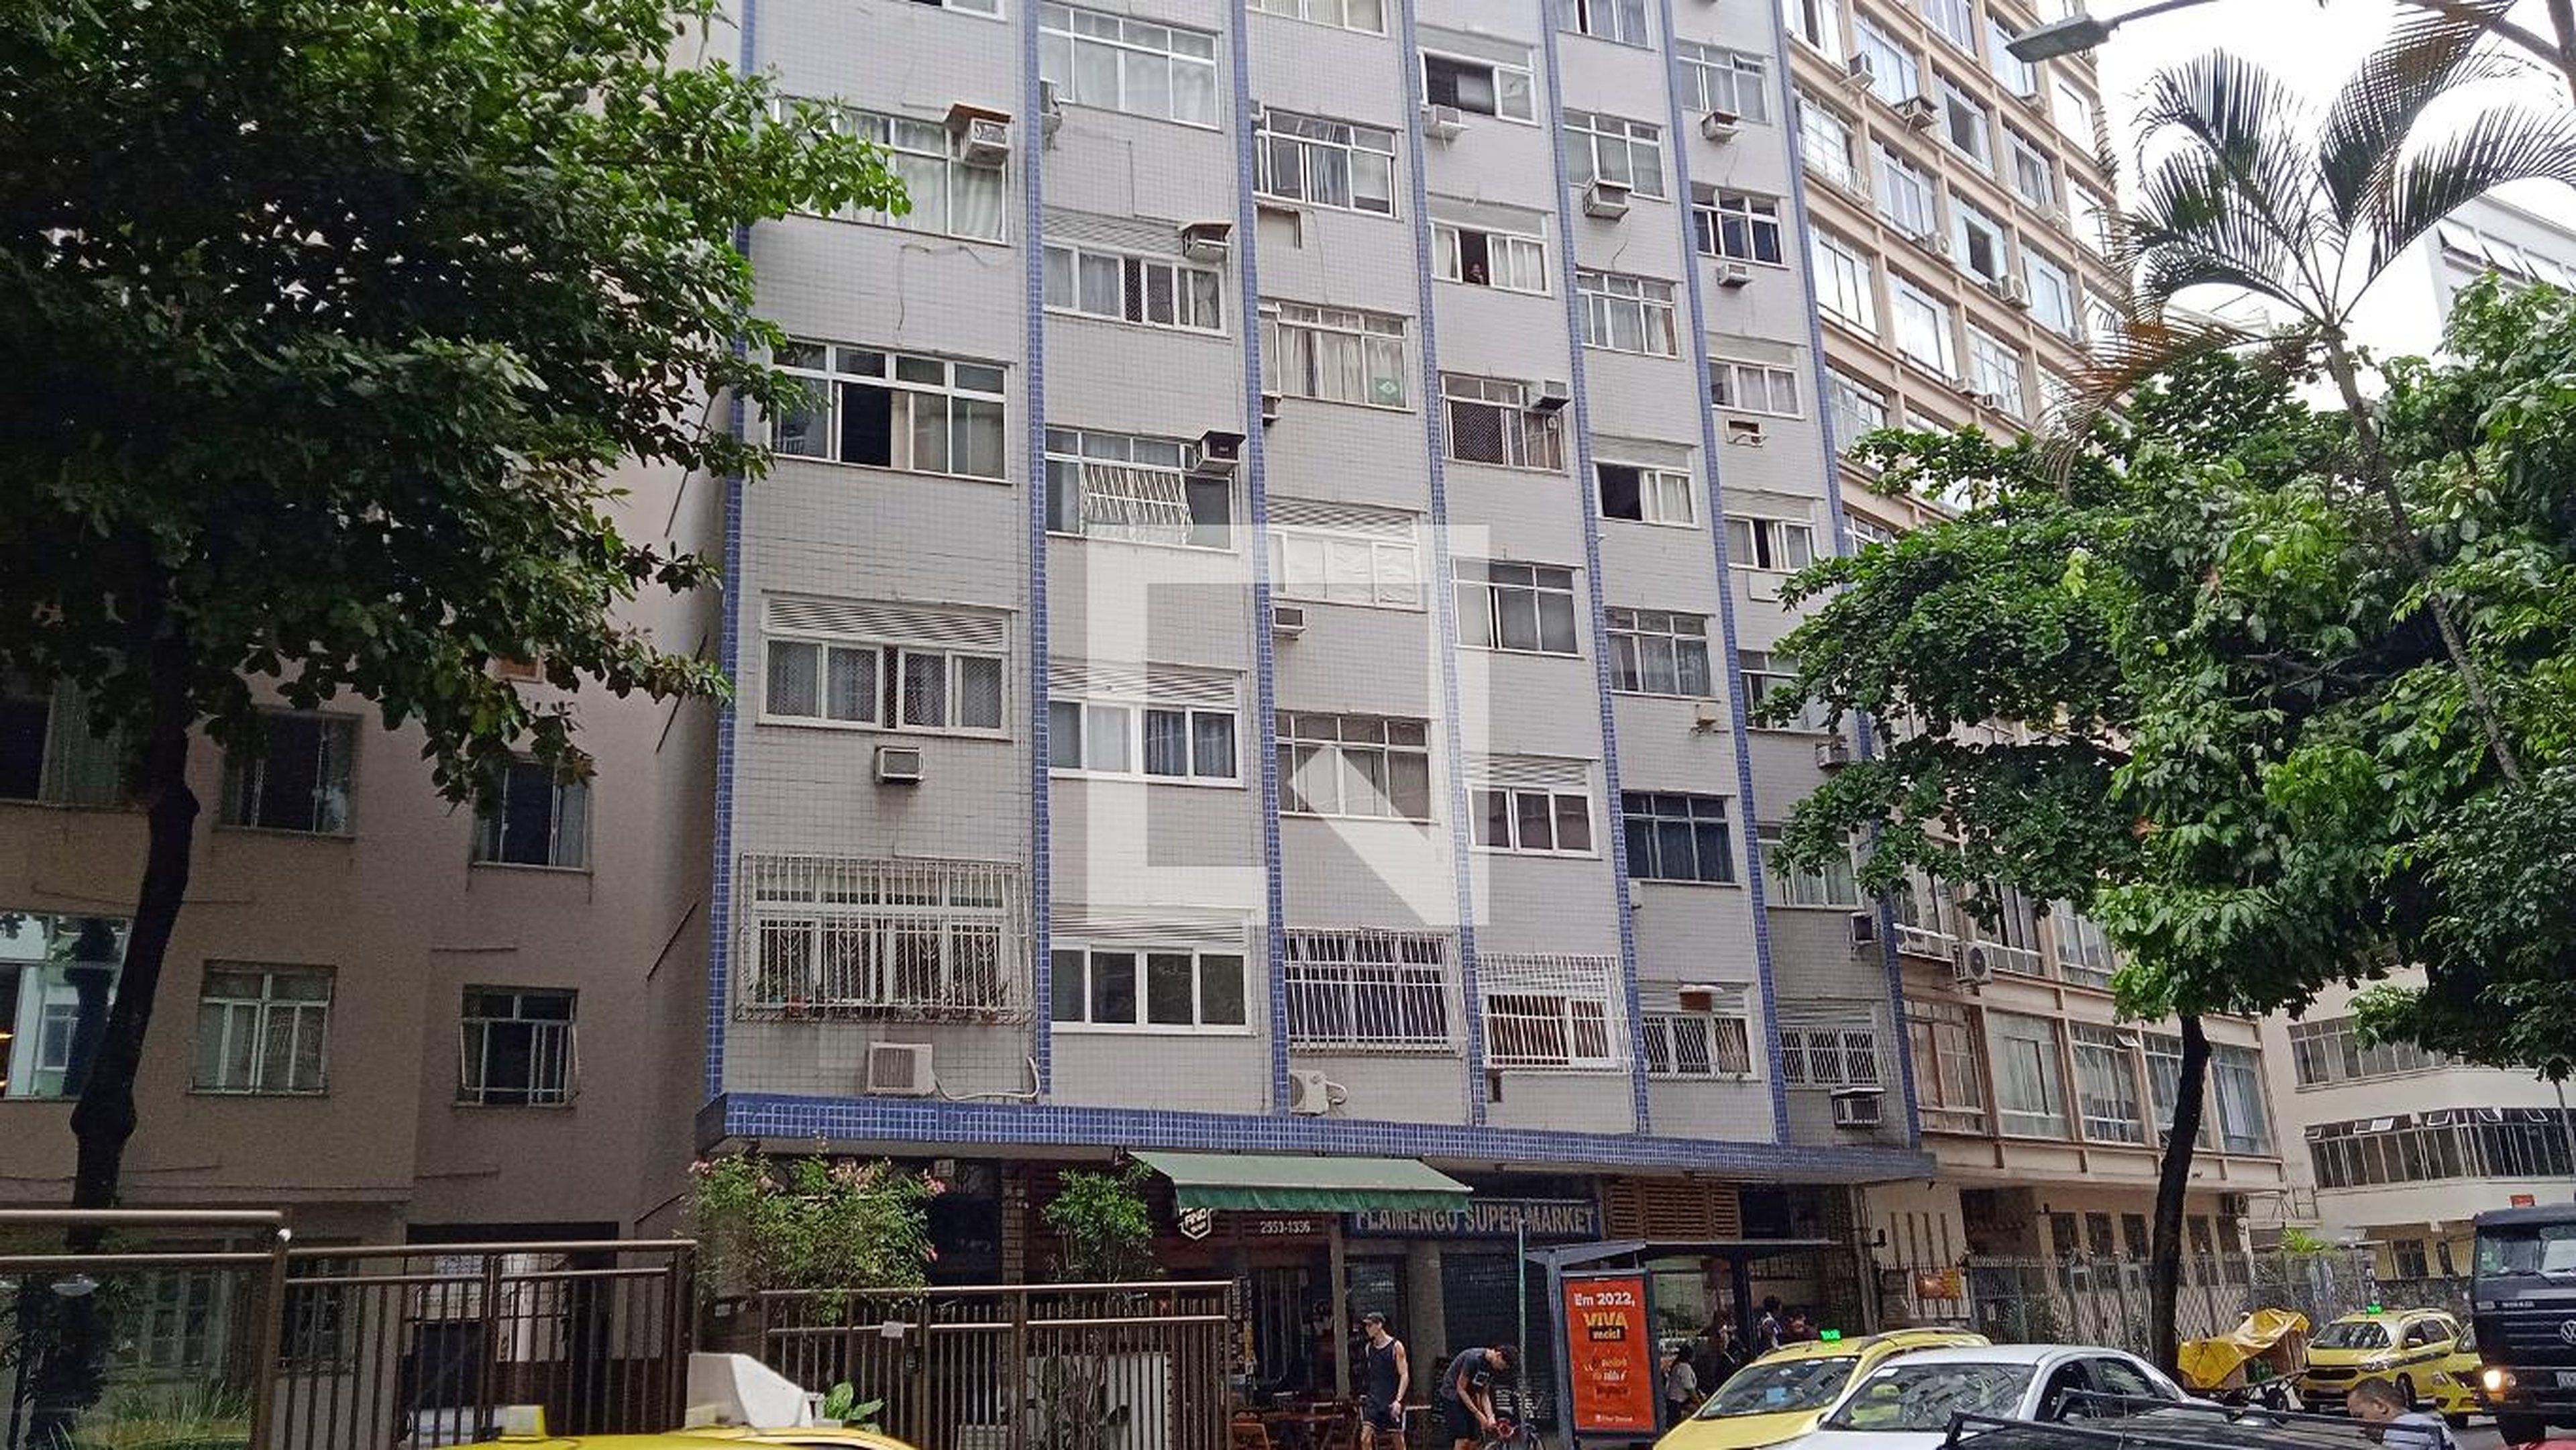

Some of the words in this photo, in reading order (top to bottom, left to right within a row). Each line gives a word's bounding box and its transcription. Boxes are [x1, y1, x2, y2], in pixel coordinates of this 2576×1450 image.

[1356, 1209, 1458, 1231] FLAMENGO
[1465, 1205, 1521, 1233] SUPER
[1525, 1206, 1594, 1233] MARKET
[1574, 1292, 1594, 1306] Em
[1597, 1292, 1635, 1307] 2022,
[1583, 1311, 1629, 1329] VIVA
